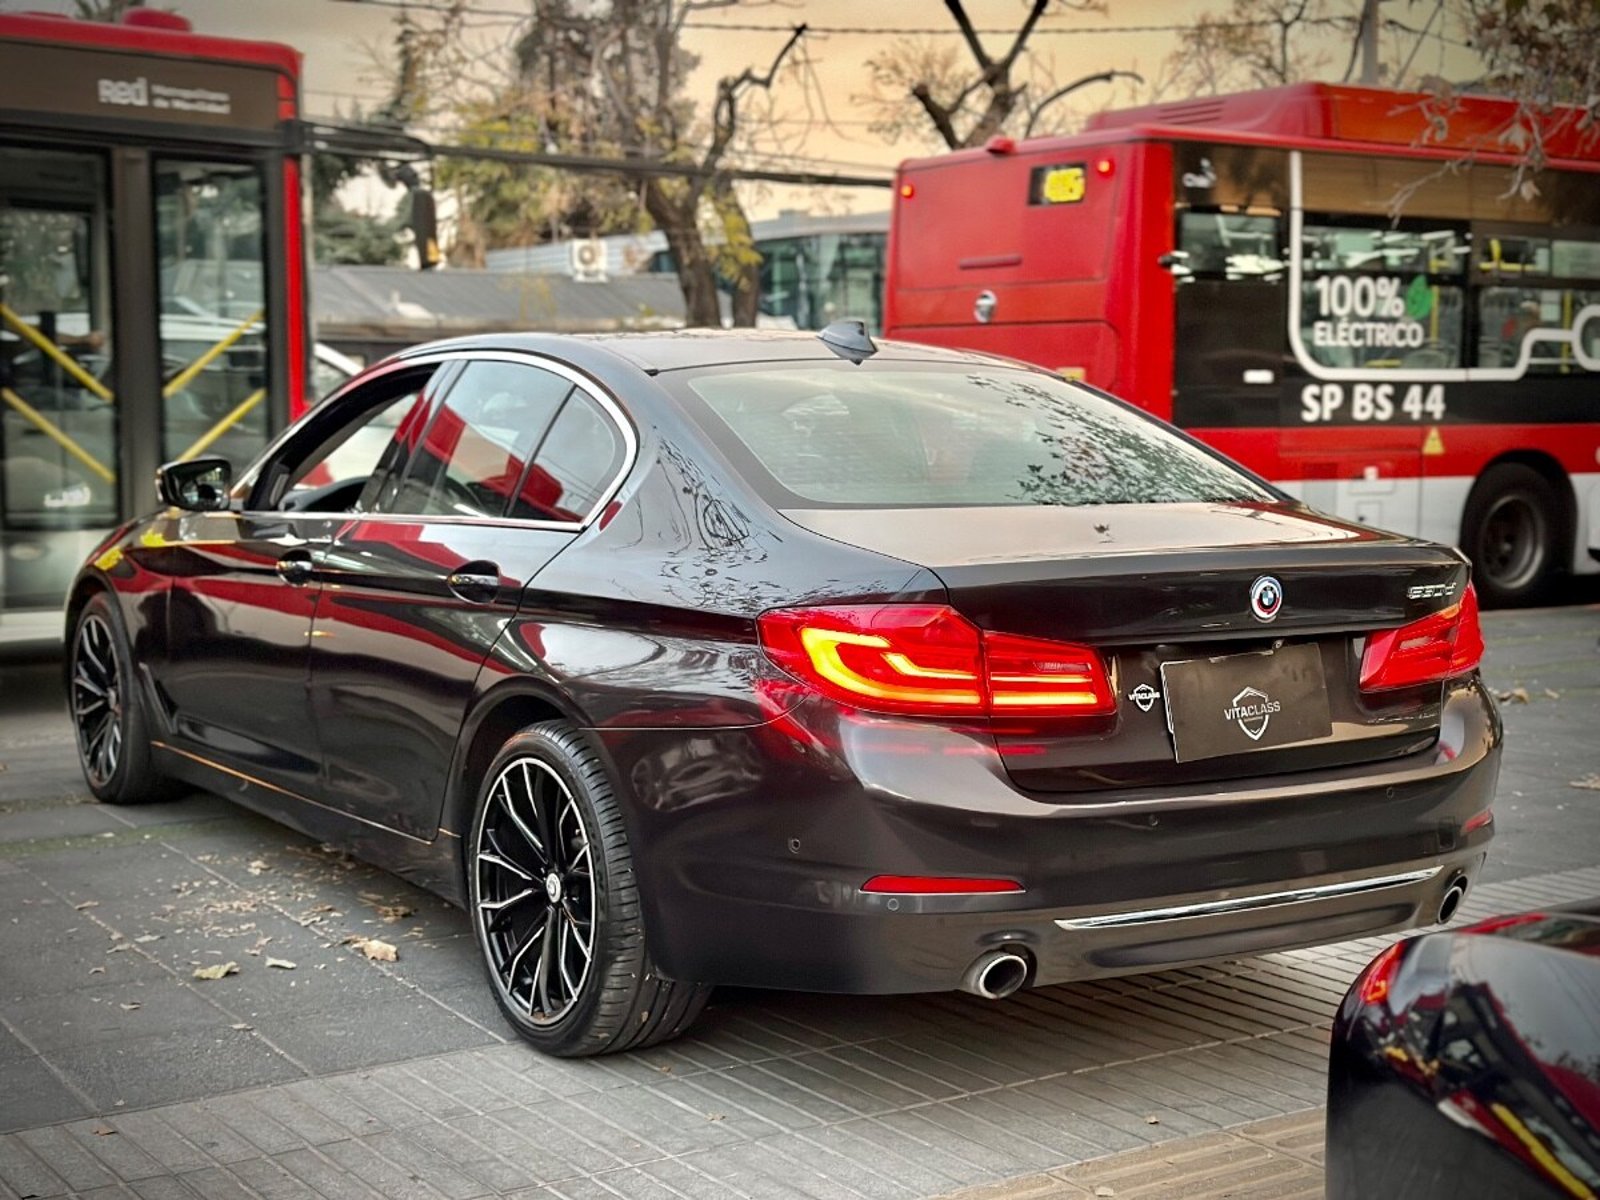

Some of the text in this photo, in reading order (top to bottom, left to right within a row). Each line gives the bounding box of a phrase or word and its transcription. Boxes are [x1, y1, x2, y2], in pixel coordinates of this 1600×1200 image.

[1316, 275, 1405, 317] 100%
[1313, 316, 1424, 348] ELÉCTRICO
[1301, 383, 1446, 422] SP BS 44
[1223, 700, 1281, 720] VITACLASS
